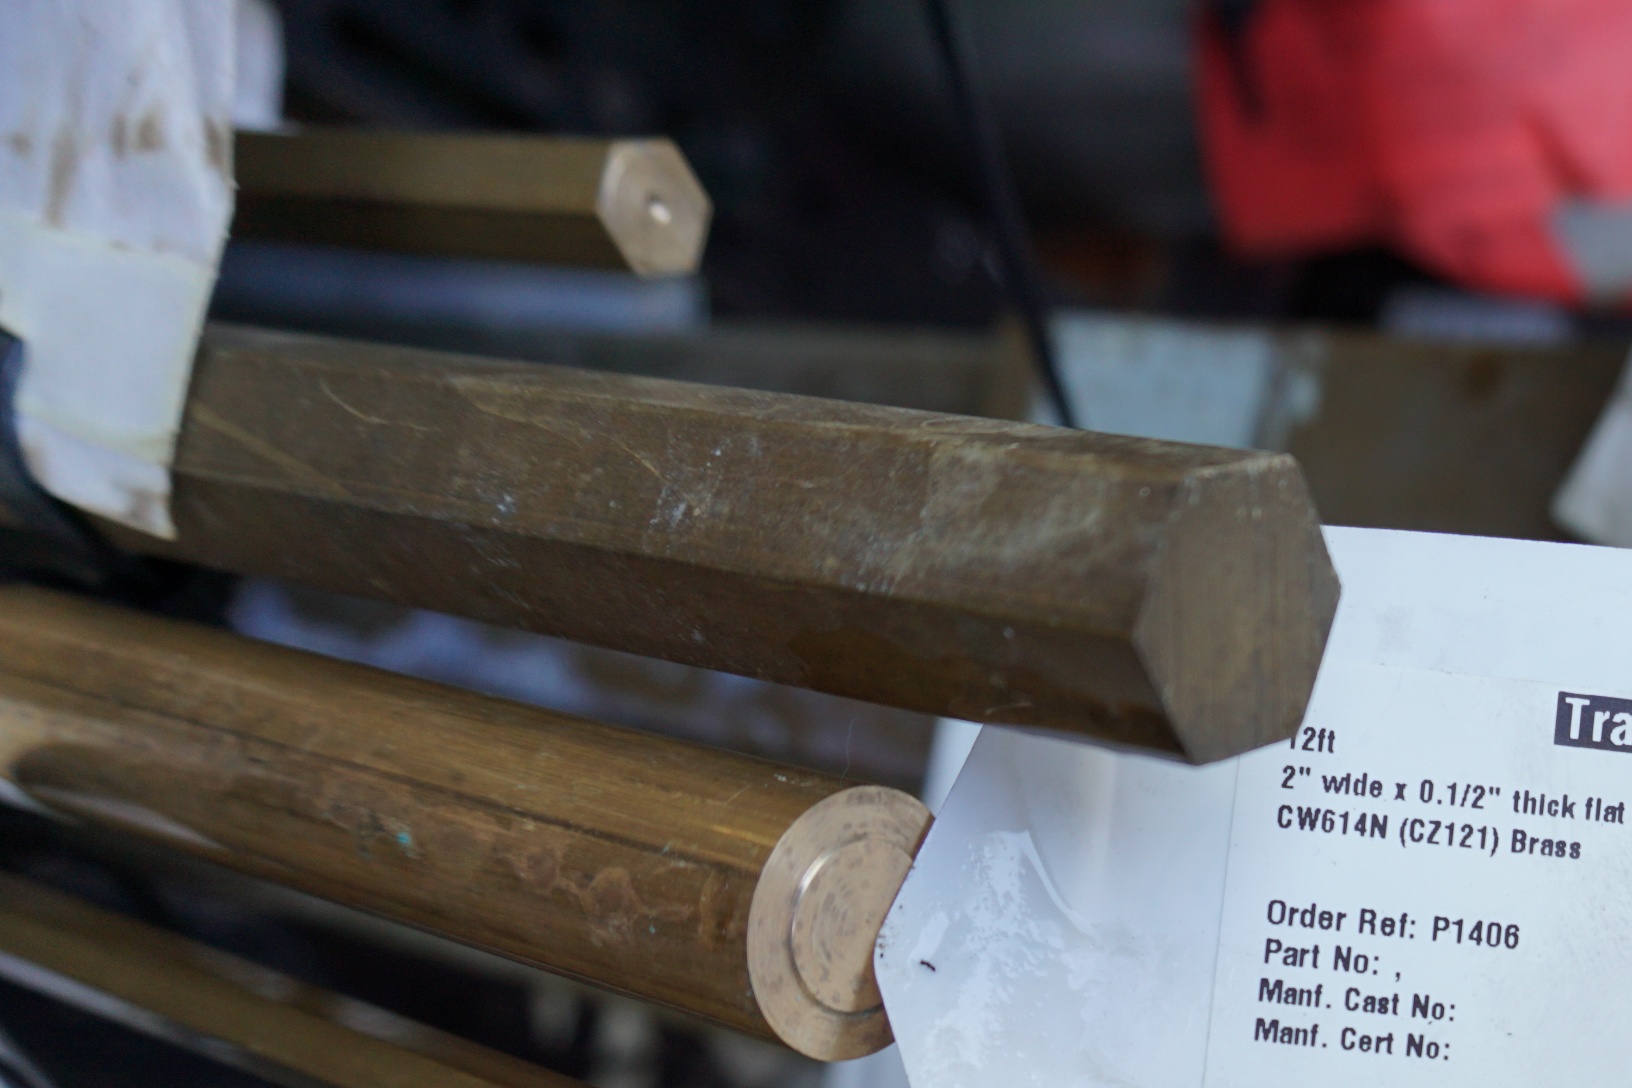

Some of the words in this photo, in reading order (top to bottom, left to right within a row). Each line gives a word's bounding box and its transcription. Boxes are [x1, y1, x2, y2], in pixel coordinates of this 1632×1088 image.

[1281, 765, 1311, 789] 2"
[1322, 773, 1383, 798] wide
[1394, 783, 1407, 801] x
[1420, 779, 1500, 809] 0.1/2"
[1513, 790, 1576, 819] thick
[1585, 797, 1625, 824] flat
[1277, 805, 1388, 839] CW614N
[1399, 818, 1499, 857] (CZ121)
[1511, 829, 1581, 859] Brass
[1267, 900, 1347, 931] Order
[1359, 908, 1415, 939] Ref:
[1432, 916, 1519, 949] P1406
[1264, 938, 1320, 969] Part
[1333, 945, 1379, 975] No:
[1258, 978, 1331, 1009] Manf.
[1345, 987, 1399, 1016] Cast
[1411, 993, 1455, 1021] No:
[1254, 1018, 1327, 1048] Manf.
[1341, 1027, 1394, 1055] Cert
[1406, 1033, 1449, 1060] No:
